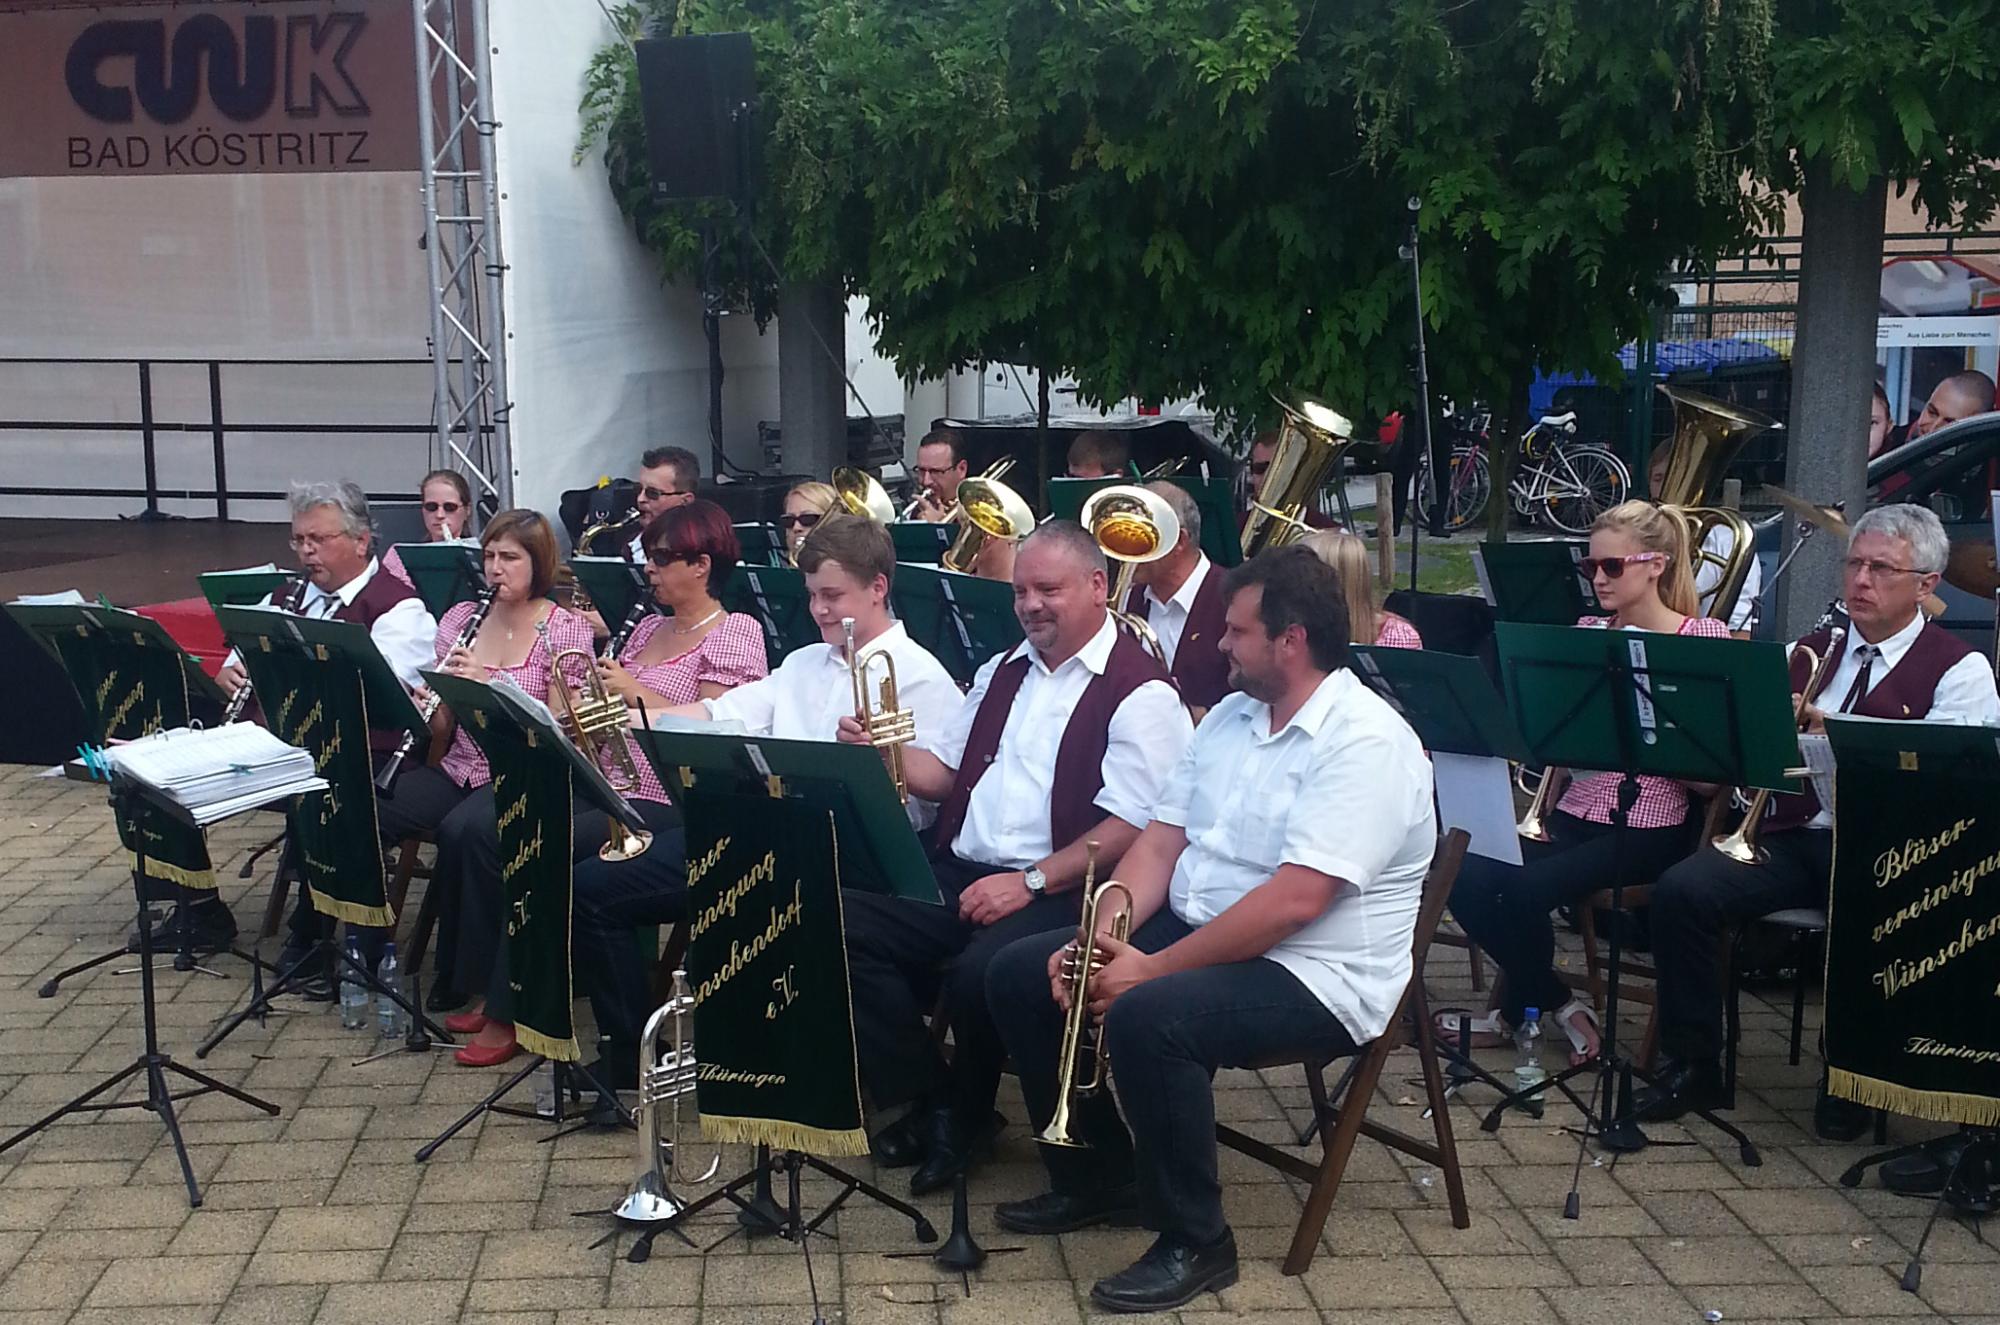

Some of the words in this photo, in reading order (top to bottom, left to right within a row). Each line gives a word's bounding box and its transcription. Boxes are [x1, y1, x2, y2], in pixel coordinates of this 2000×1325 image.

[68, 136, 150, 168] BAD
[165, 127, 370, 167] KÖSTRITZ
[1956, 331, 1991, 339] Menschen
[1873, 817, 1976, 888] Bläser-
[690, 850, 776, 942] einigung
[766, 964, 800, 1020] e.V.
[1903, 1036, 2000, 1064] Thüringe
[697, 1062, 786, 1088] Thüringen
